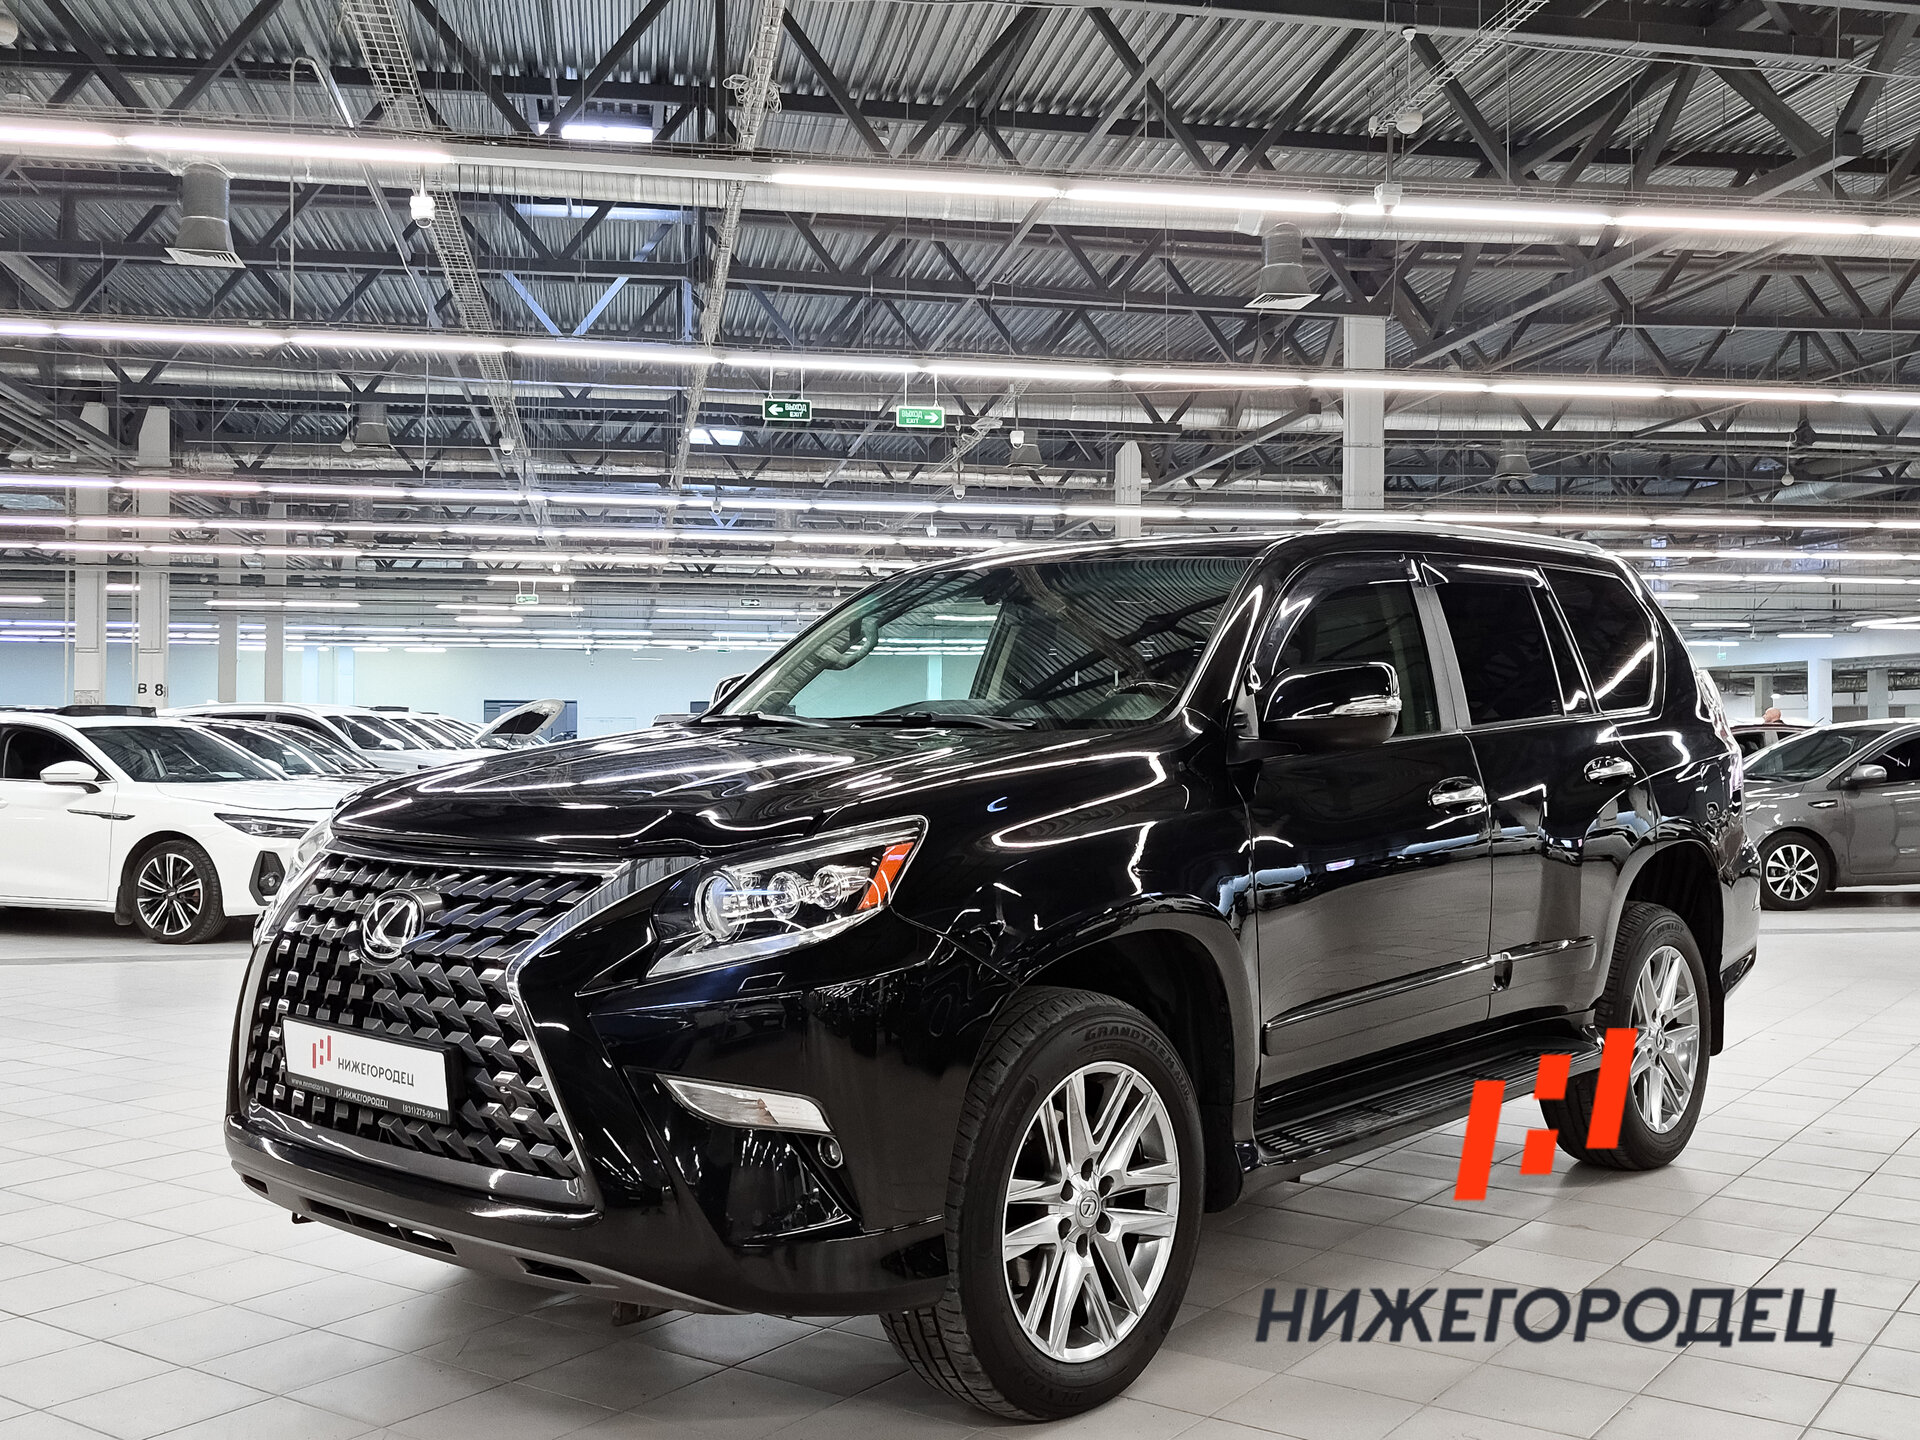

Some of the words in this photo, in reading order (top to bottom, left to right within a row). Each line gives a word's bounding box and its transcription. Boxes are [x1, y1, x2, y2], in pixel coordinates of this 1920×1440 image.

[785, 403, 807, 412] ВЫХОД
[902, 410, 923, 419] ВЫХОД
[155, 684, 164, 696] 8
[337, 1057, 415, 1087] НИЖЕГОРОДЕЦ
[343, 1089, 389, 1109] НИЖЕГОРОДЕЦ
